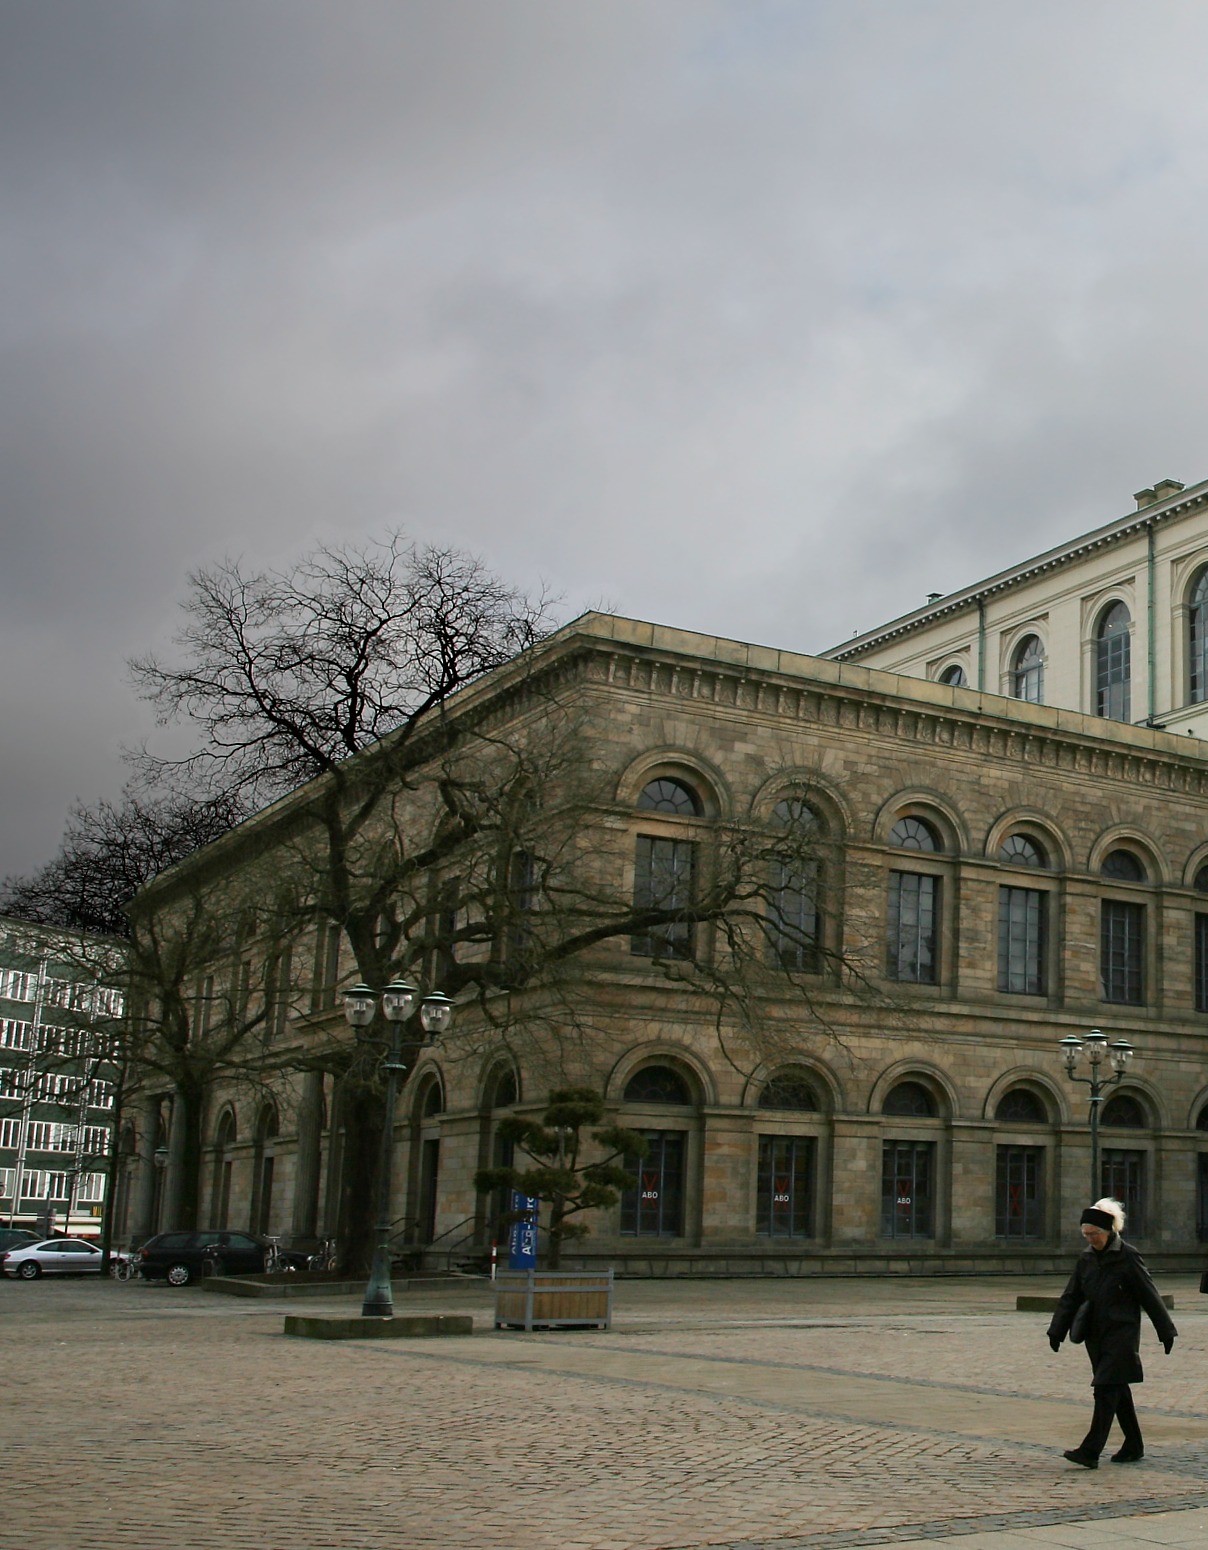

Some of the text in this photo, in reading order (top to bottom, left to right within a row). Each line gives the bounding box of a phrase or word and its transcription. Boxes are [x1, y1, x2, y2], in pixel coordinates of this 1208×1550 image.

[641, 1190, 658, 1199] ABO
[774, 1194, 790, 1203] ABO
[897, 1197, 911, 1205] ABO
